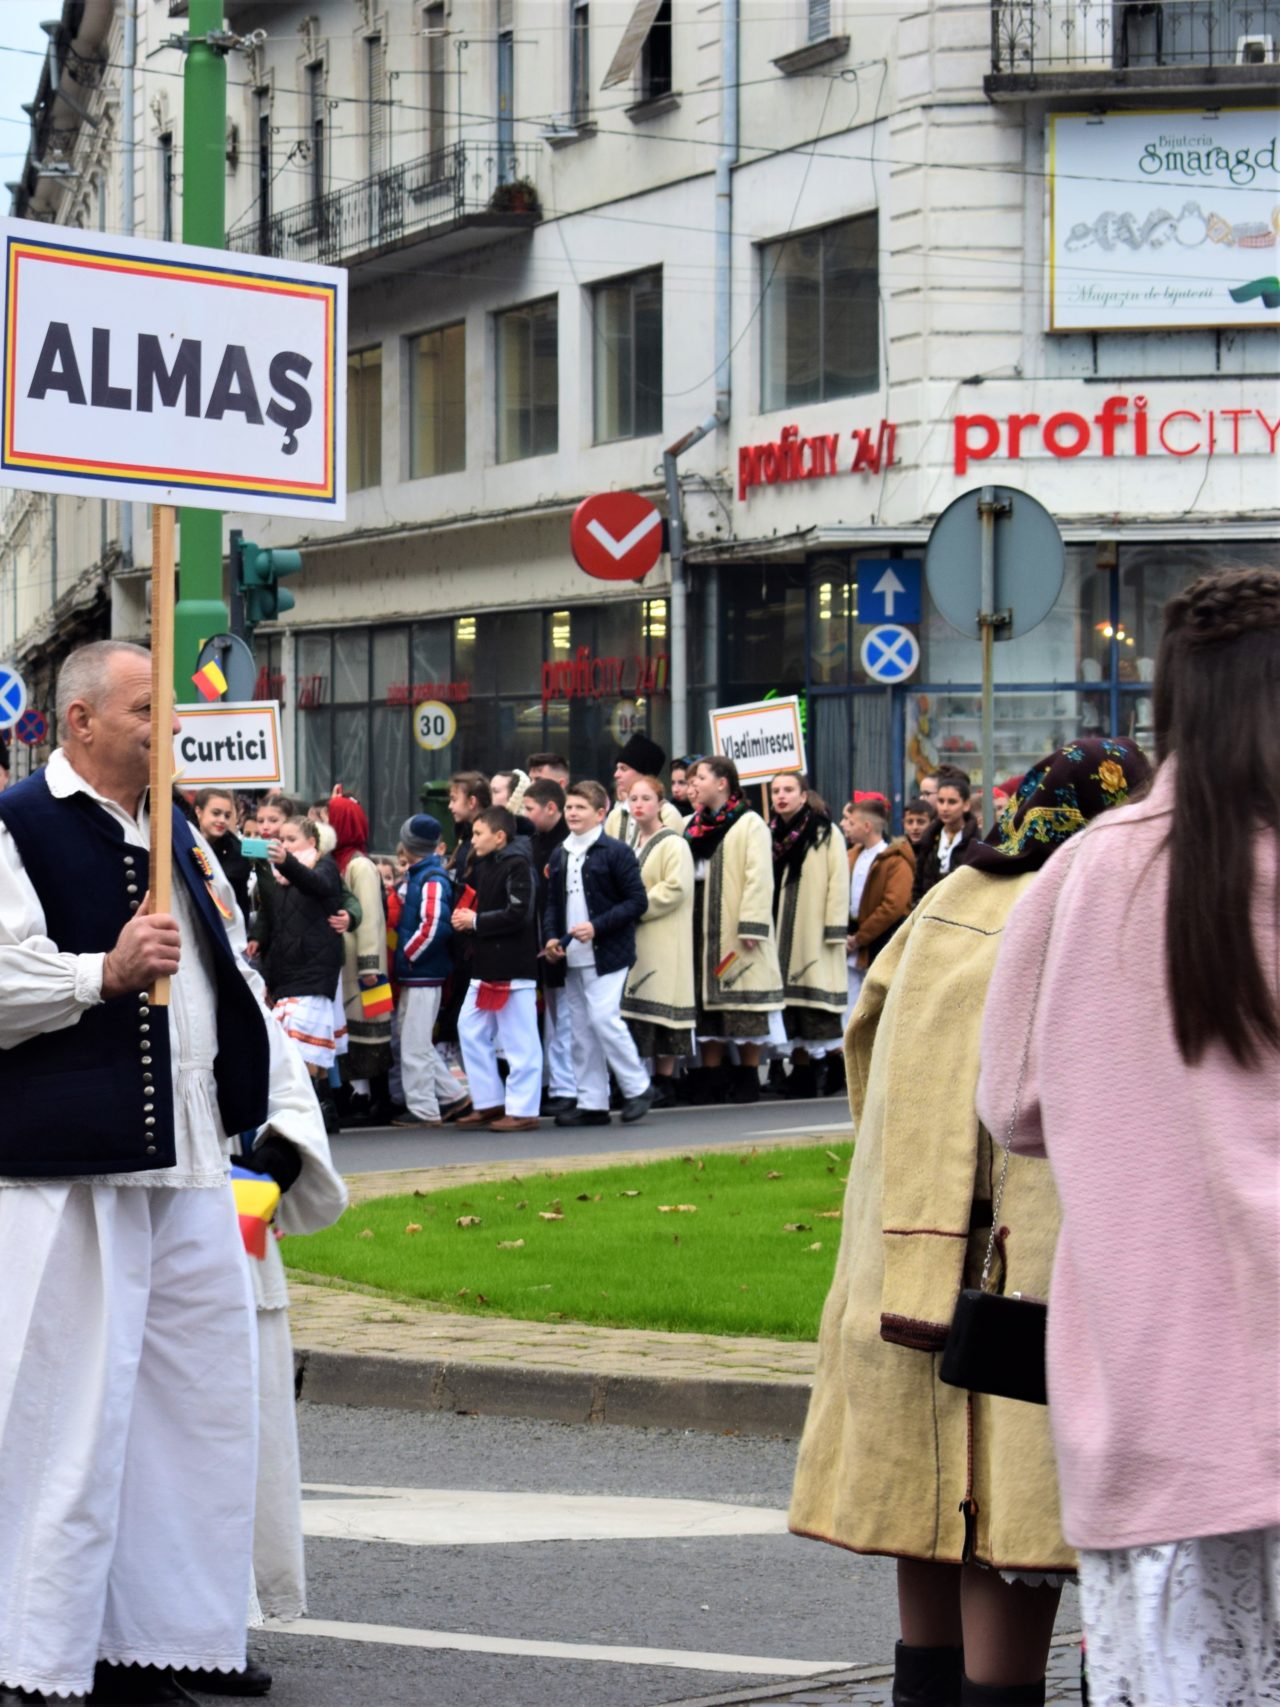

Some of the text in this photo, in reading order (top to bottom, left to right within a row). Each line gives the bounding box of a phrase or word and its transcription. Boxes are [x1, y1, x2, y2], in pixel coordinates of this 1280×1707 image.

[1159, 134, 1213, 149] Bijuteria
[1138, 137, 1280, 185] Smaragd
[1068, 284, 1139, 309] Magazin
[1144, 286, 1160, 300] de
[420, 714, 445, 736] 30
[181, 729, 267, 762] Curtici
[721, 728, 795, 761] Vladimirescu
